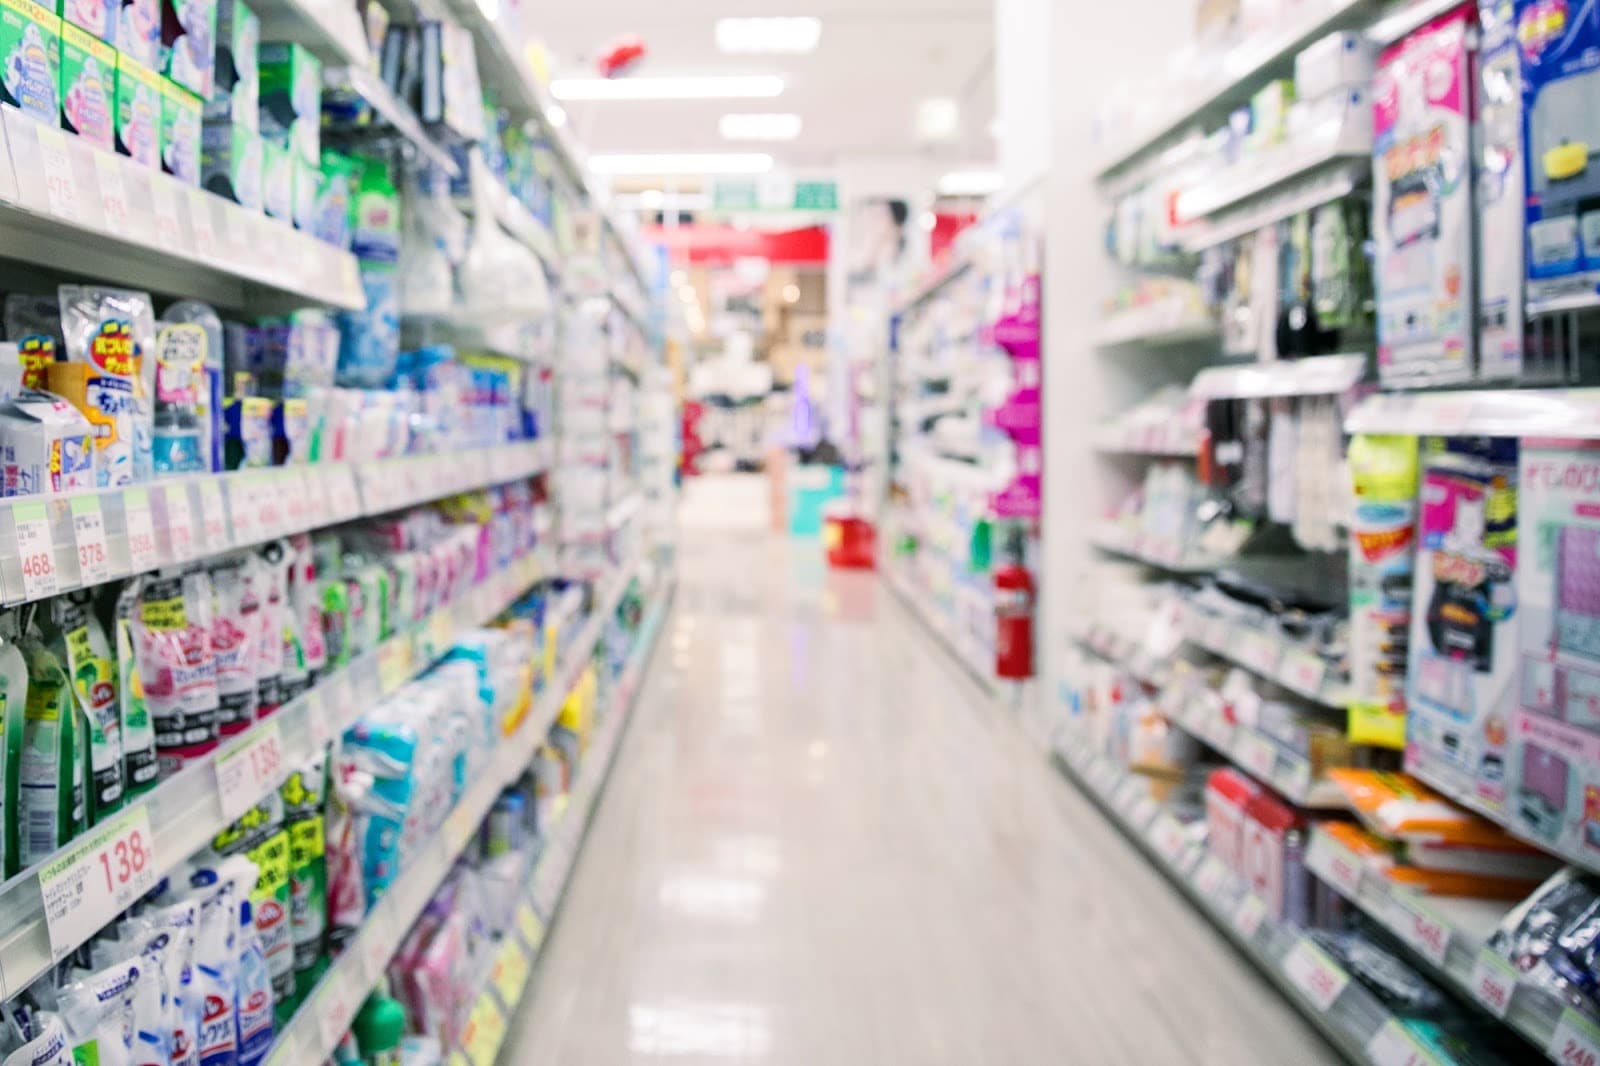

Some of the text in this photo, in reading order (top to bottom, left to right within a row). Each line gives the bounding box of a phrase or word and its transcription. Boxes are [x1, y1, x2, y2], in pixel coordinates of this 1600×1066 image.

[22, 552, 52, 577] 468
[79, 543, 104, 567] 378
[98, 829, 148, 893] 138
